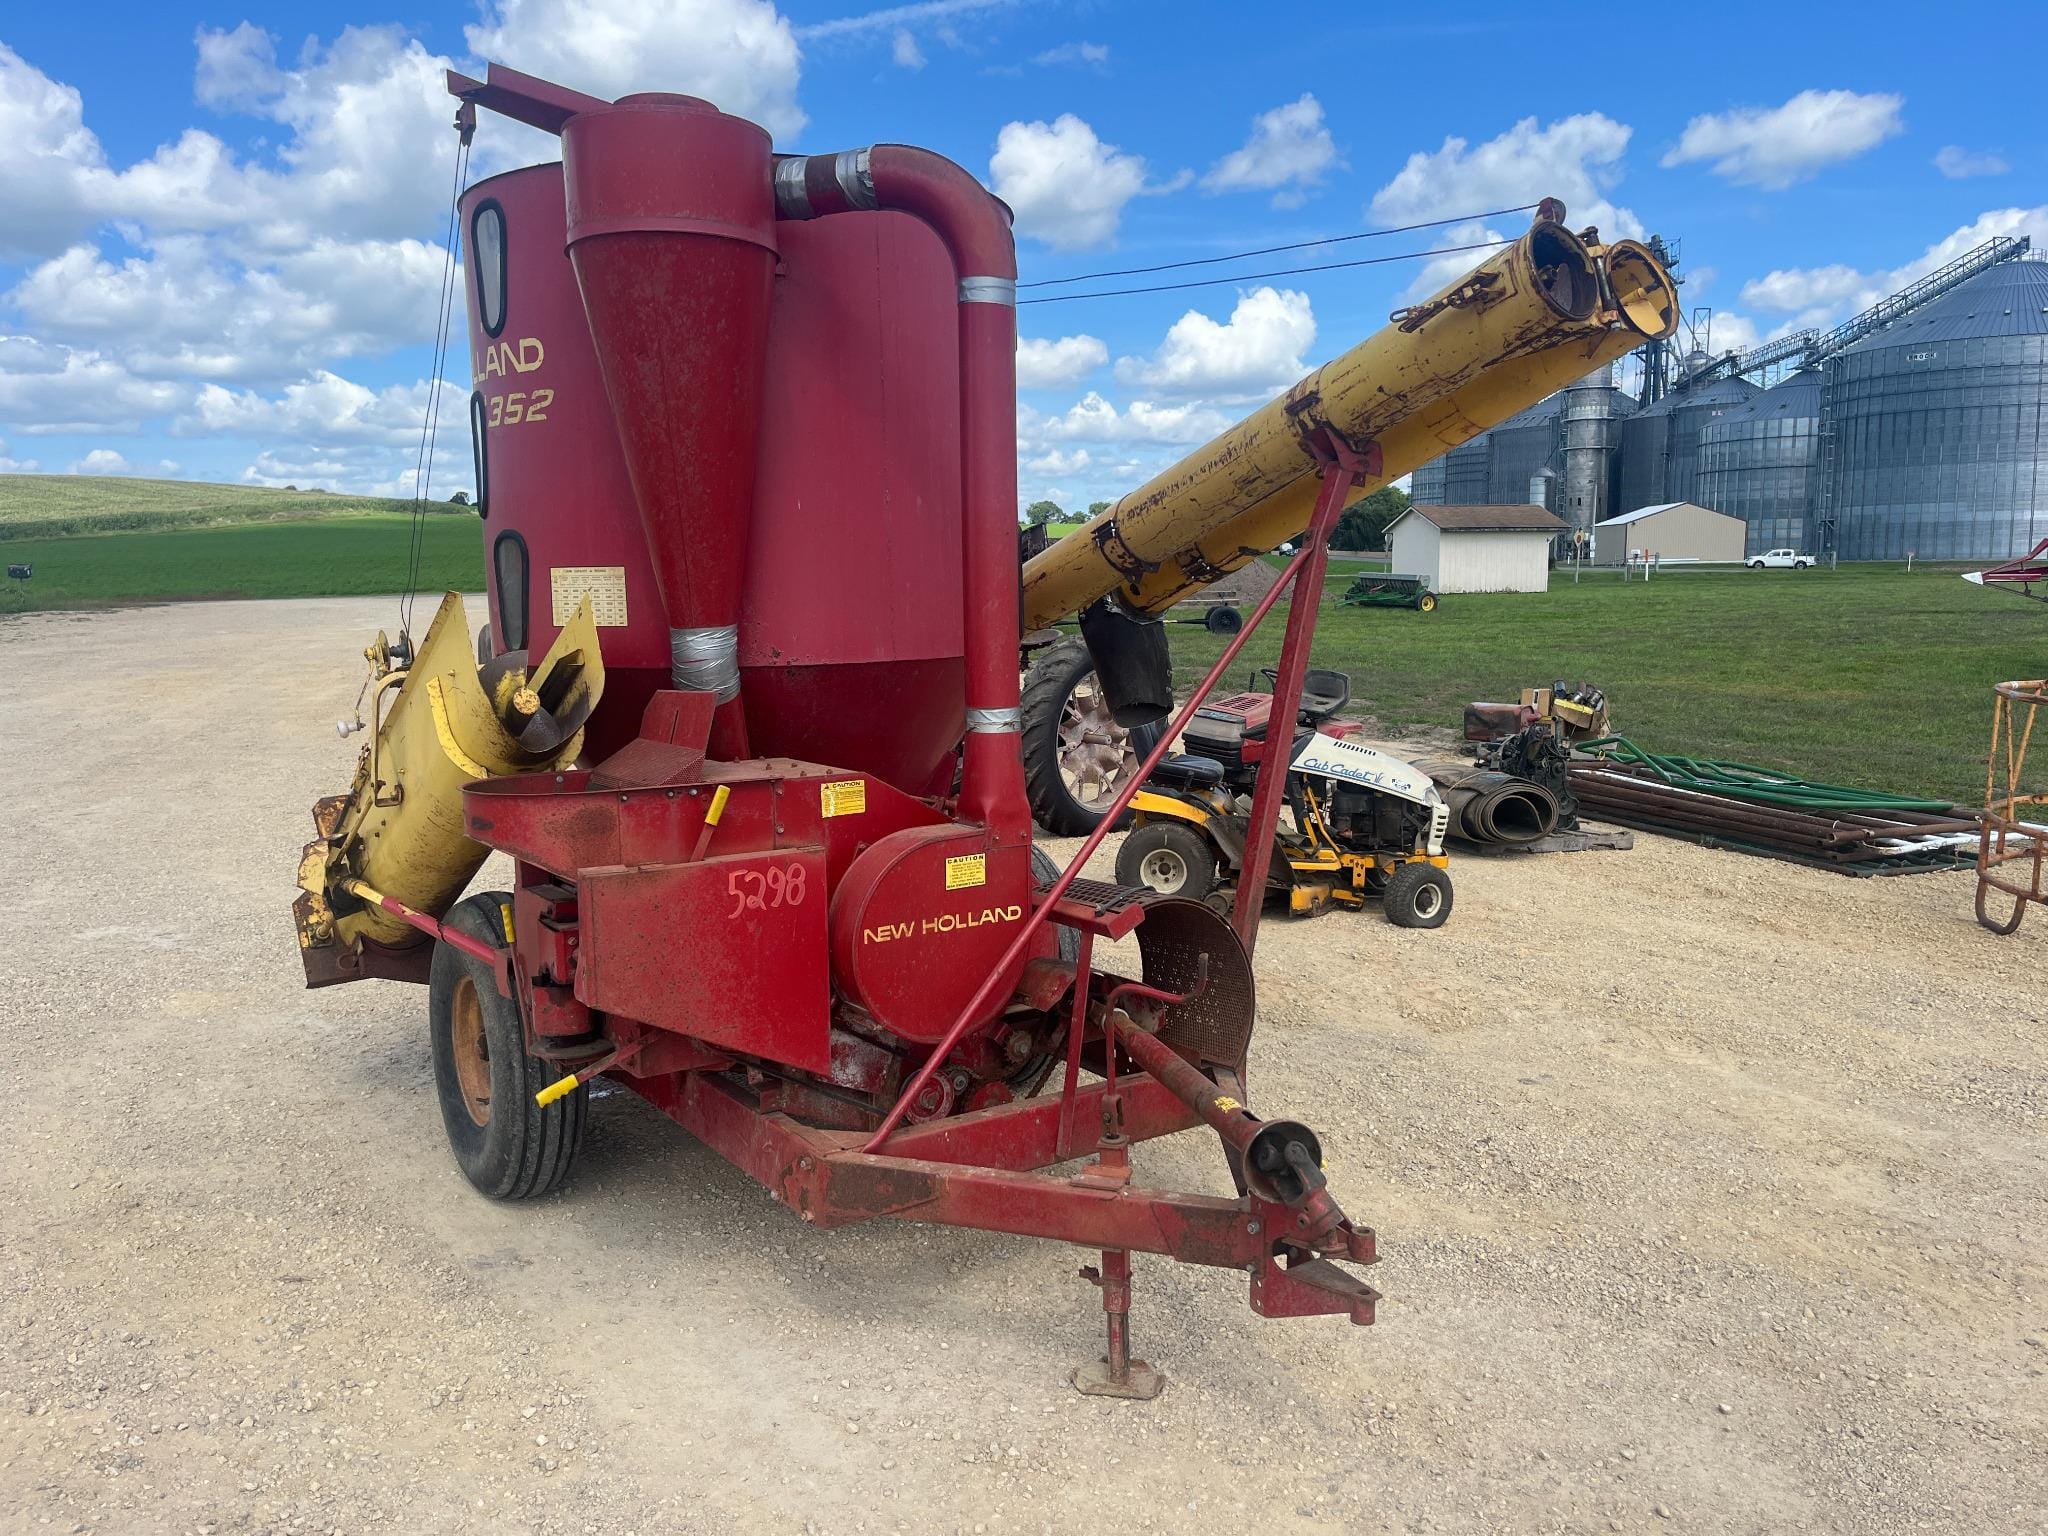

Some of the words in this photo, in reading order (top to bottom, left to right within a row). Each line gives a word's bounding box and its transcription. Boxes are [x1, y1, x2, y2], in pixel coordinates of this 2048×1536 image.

[487, 389, 555, 428] 352
[1303, 758, 1329, 771] Cub
[1330, 764, 1375, 781] Cadet
[947, 855, 984, 864] CAUTION
[728, 862, 807, 919] 5298
[863, 921, 915, 945] NEW
[922, 905, 1022, 935] HOLLAND
